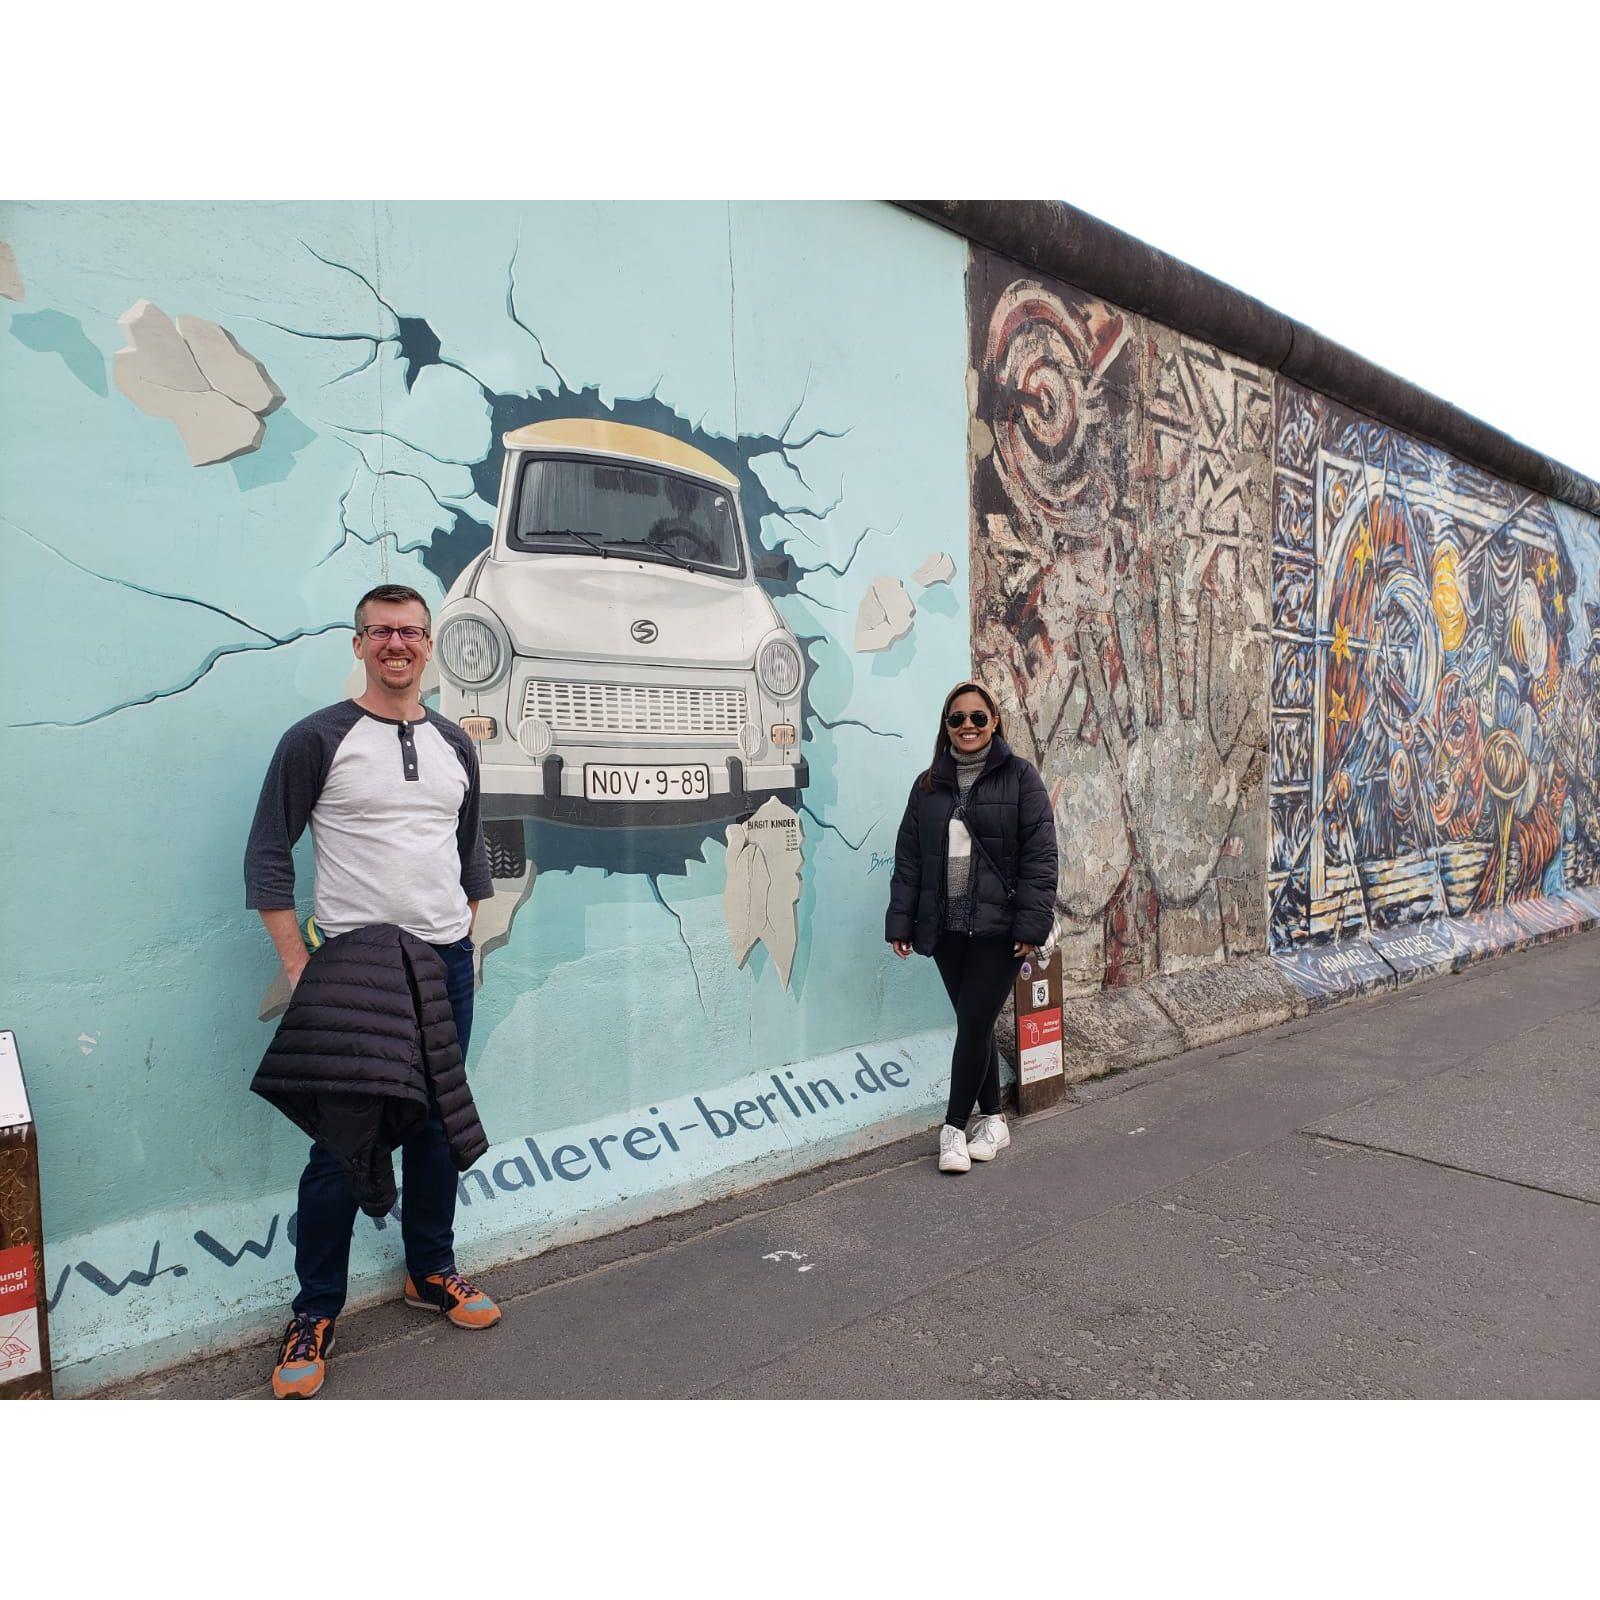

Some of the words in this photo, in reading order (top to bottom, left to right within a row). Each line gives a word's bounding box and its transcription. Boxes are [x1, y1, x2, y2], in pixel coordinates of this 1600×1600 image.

[747, 820, 768, 830] BIRGIT
[771, 818, 797, 829] KINDER
[1319, 949, 1375, 973] HIMMEL
